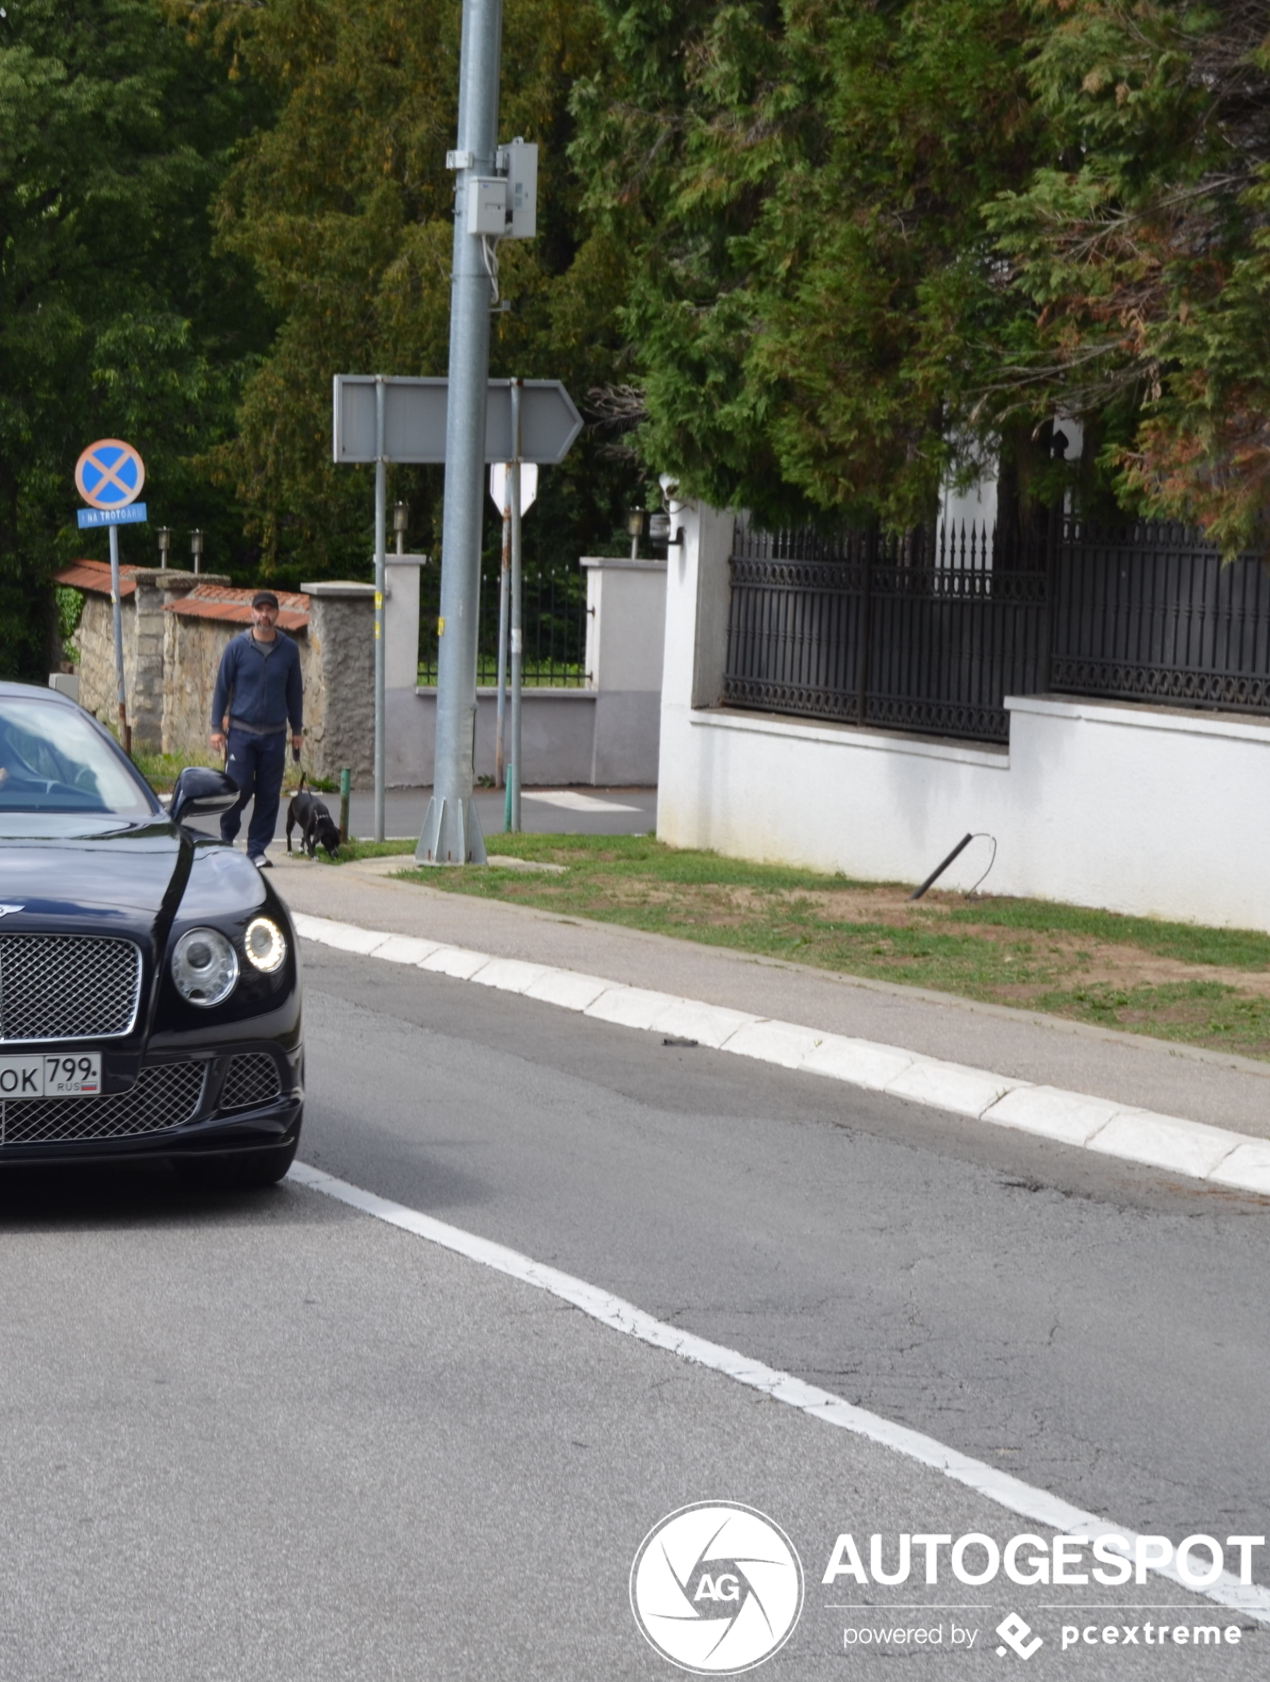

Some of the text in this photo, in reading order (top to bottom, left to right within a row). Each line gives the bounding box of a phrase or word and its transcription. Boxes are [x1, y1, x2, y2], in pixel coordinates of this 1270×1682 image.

[87, 513, 98, 523] NA
[100, 507, 142, 522] TROTOARU
[46, 1057, 92, 1082] 799
[57, 1082, 80, 1092] RUS
